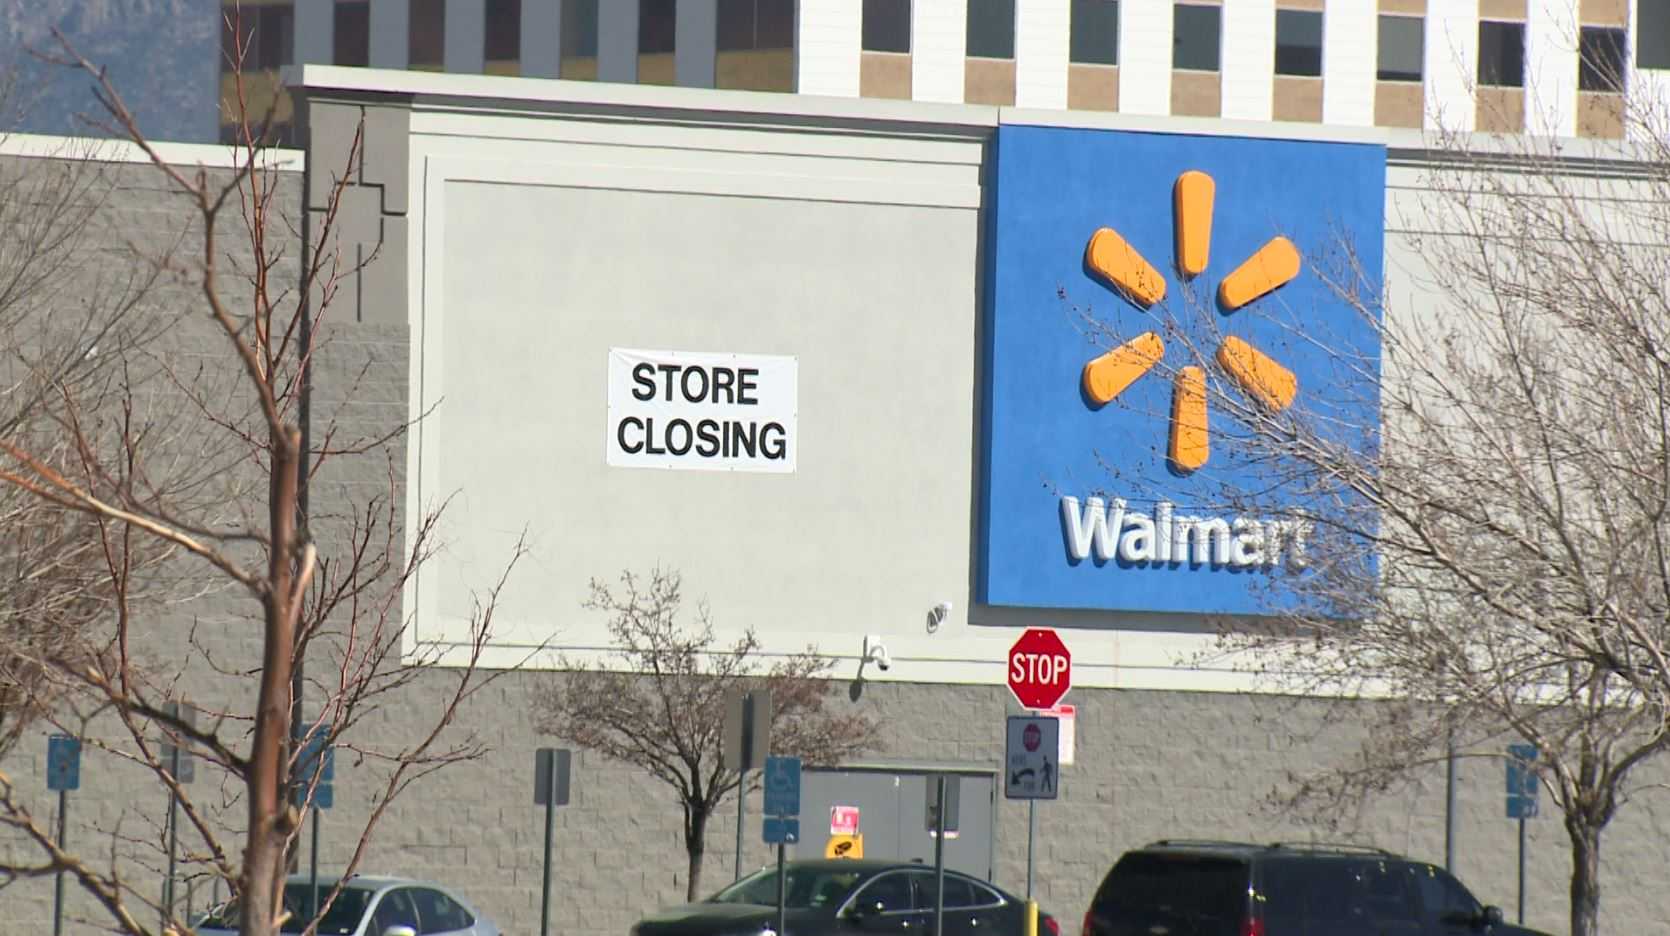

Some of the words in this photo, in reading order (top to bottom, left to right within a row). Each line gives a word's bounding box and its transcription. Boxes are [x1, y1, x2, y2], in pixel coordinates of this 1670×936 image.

[632, 362, 759, 405] STORE
[617, 416, 787, 460] CLOSING
[1060, 496, 1314, 566] Walmart
[1011, 652, 1068, 685] STOP
